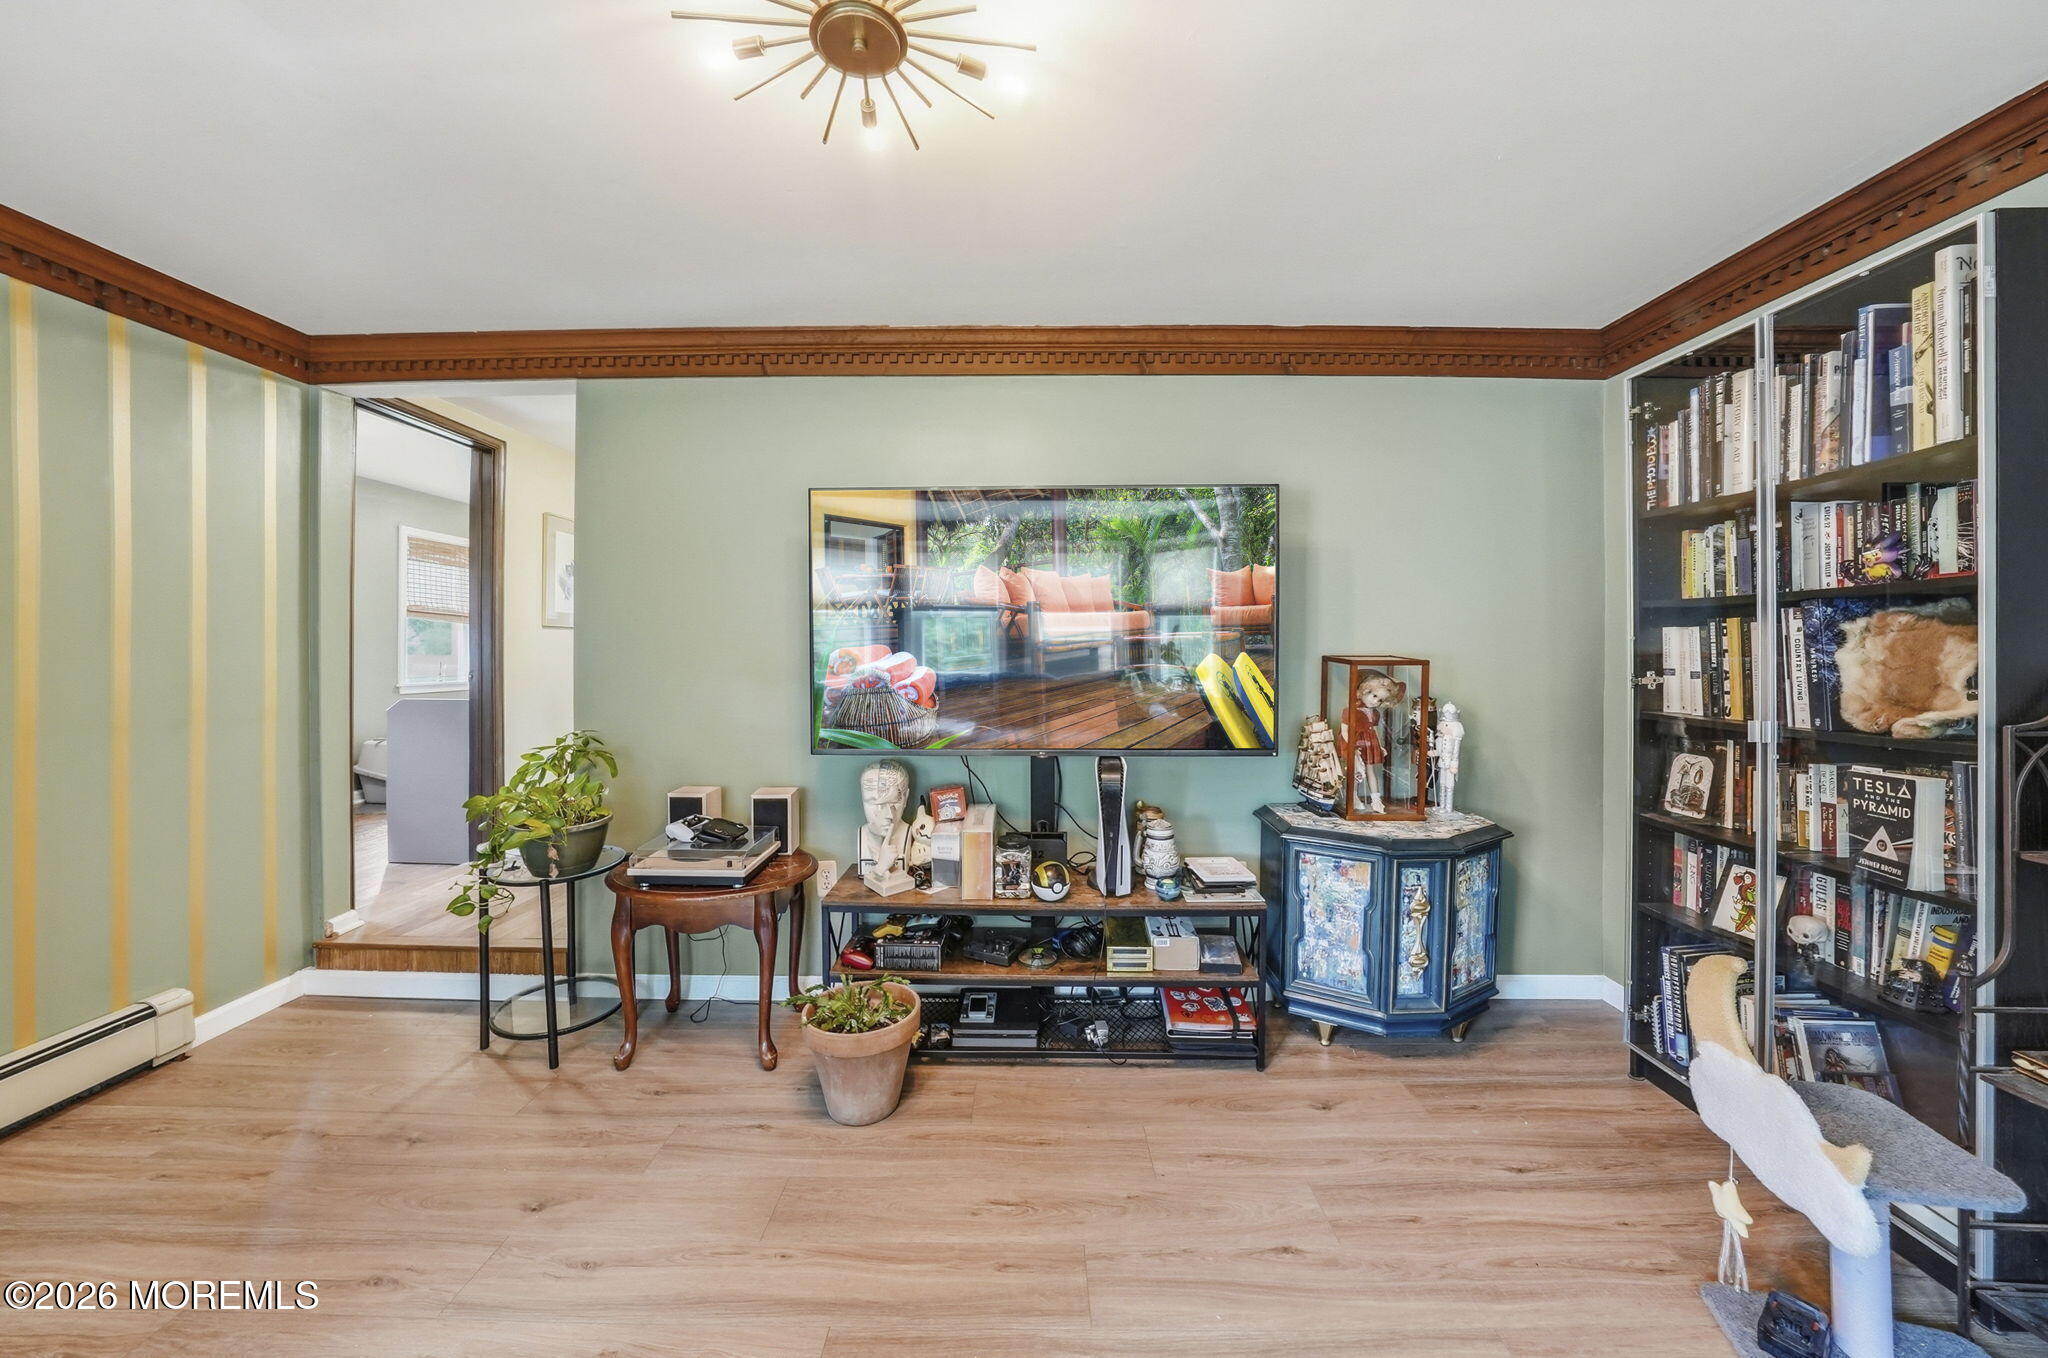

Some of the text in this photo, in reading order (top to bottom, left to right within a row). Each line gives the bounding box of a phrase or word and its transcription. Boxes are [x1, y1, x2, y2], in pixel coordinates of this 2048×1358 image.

[1794, 638, 1804, 701] COUNTRY LIVING
[1810, 647, 1818, 683] MANRESA
[1852, 777, 1912, 800] TESLA
[1853, 798, 1911, 819] PYRAMID
[1880, 864, 1902, 876] BROWN
[1815, 876, 1828, 911] GULAG
